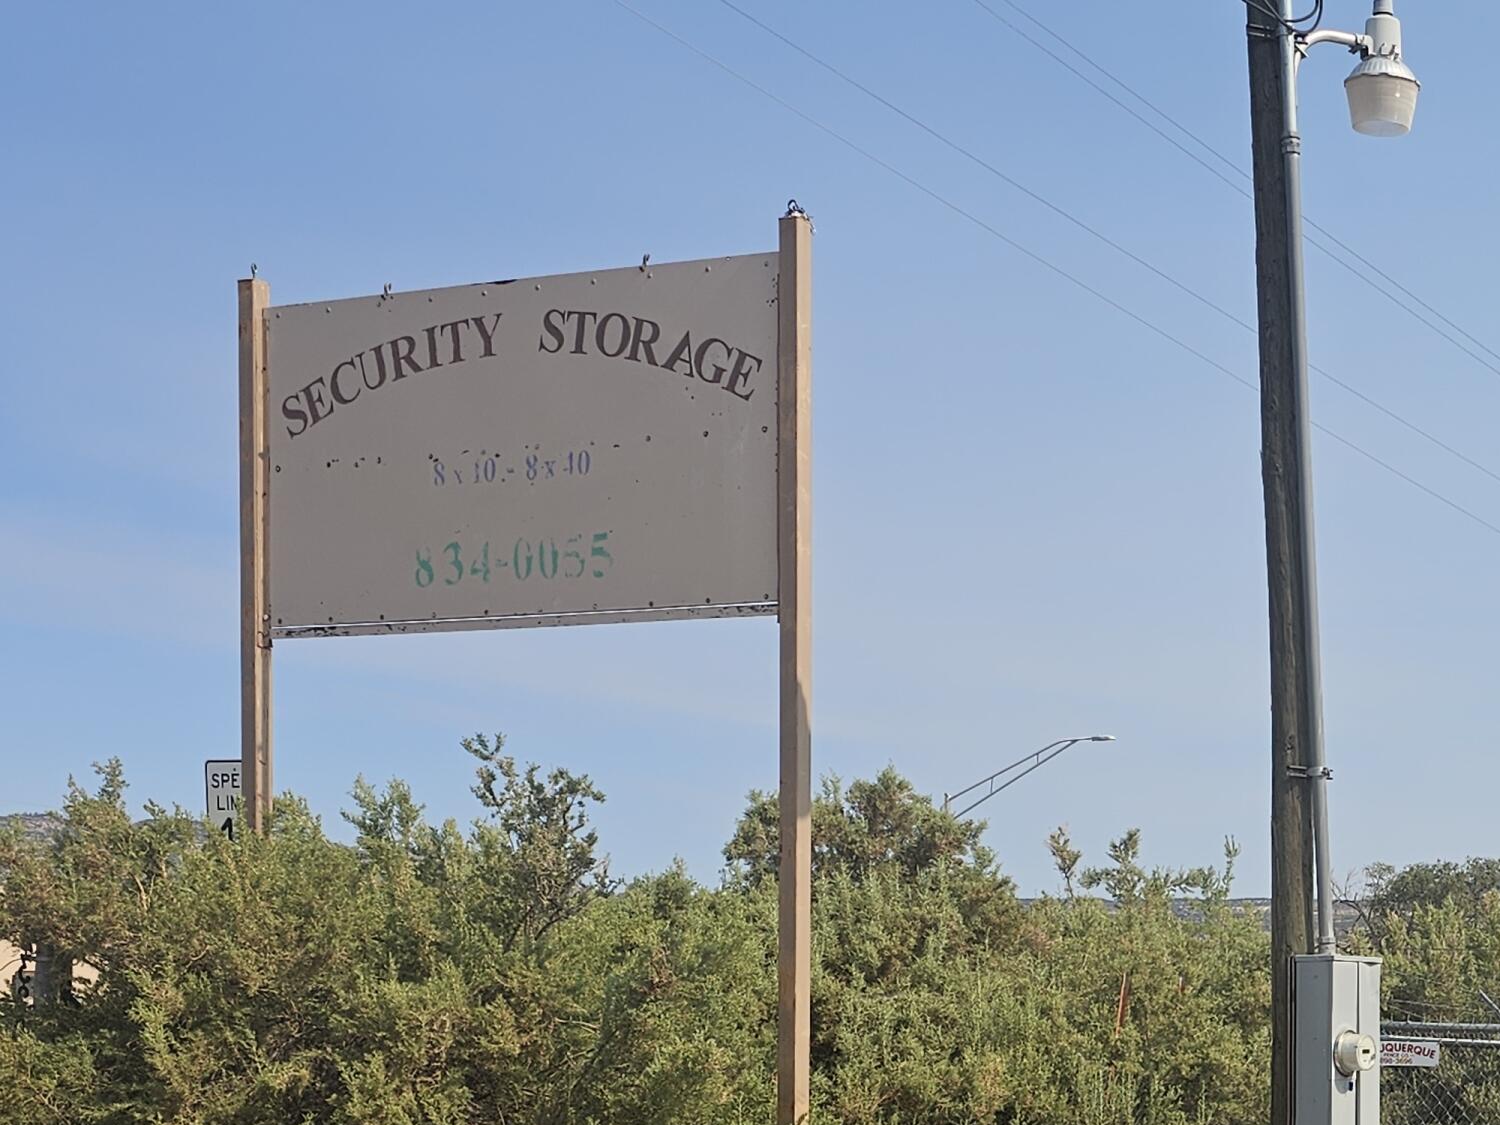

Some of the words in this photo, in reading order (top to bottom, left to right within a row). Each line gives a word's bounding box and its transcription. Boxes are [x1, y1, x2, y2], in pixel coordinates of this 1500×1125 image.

[281, 312, 503, 439] SECURITY
[538, 309, 763, 401] STORAGE
[433, 461, 446, 487] 8
[525, 454, 538, 481] 8
[415, 532, 614, 588] 834-0055
[211, 773, 241, 788] SPE
[1380, 1043, 1437, 1060] UQUERQUE
